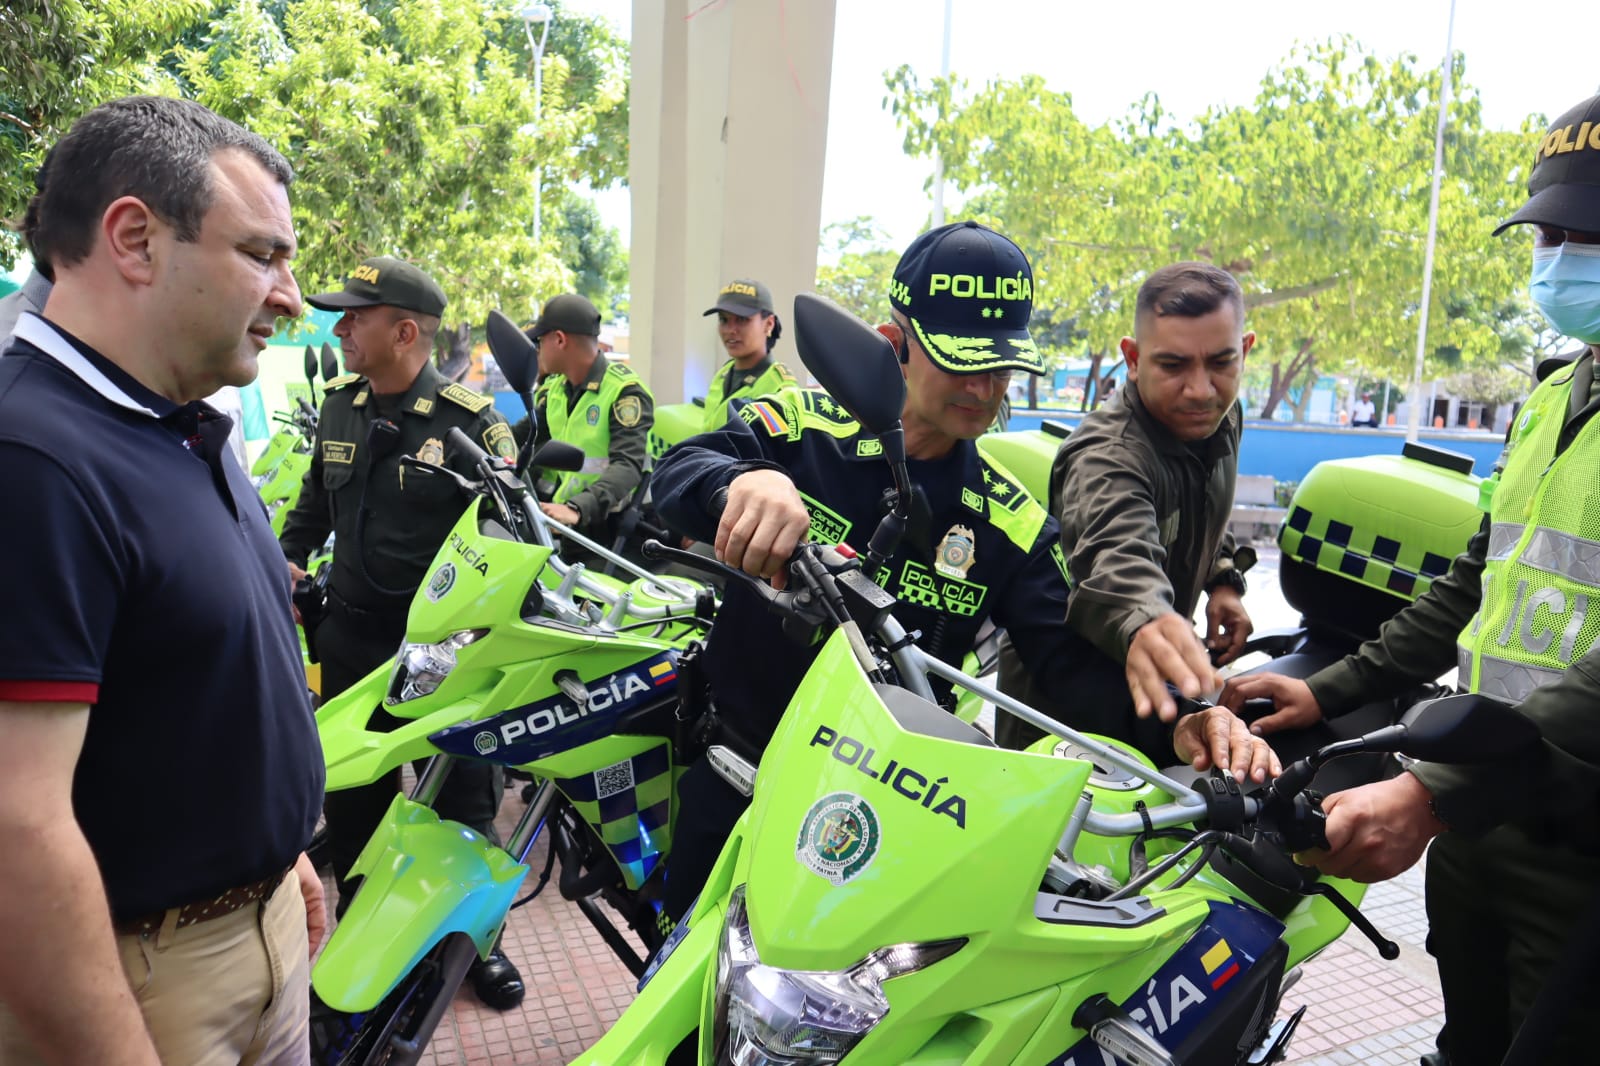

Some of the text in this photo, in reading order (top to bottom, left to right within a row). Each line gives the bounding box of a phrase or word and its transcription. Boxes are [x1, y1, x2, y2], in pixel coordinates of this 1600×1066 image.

[929, 270, 1032, 301] POLICÍA
[448, 532, 489, 577] POLICÍA
[906, 570, 975, 604] POLICÍA
[500, 674, 651, 746] POLICÍA
[809, 724, 967, 830] POLICÍA
[816, 866, 838, 876] PATRIA
[820, 858, 853, 867] NACIONAL
